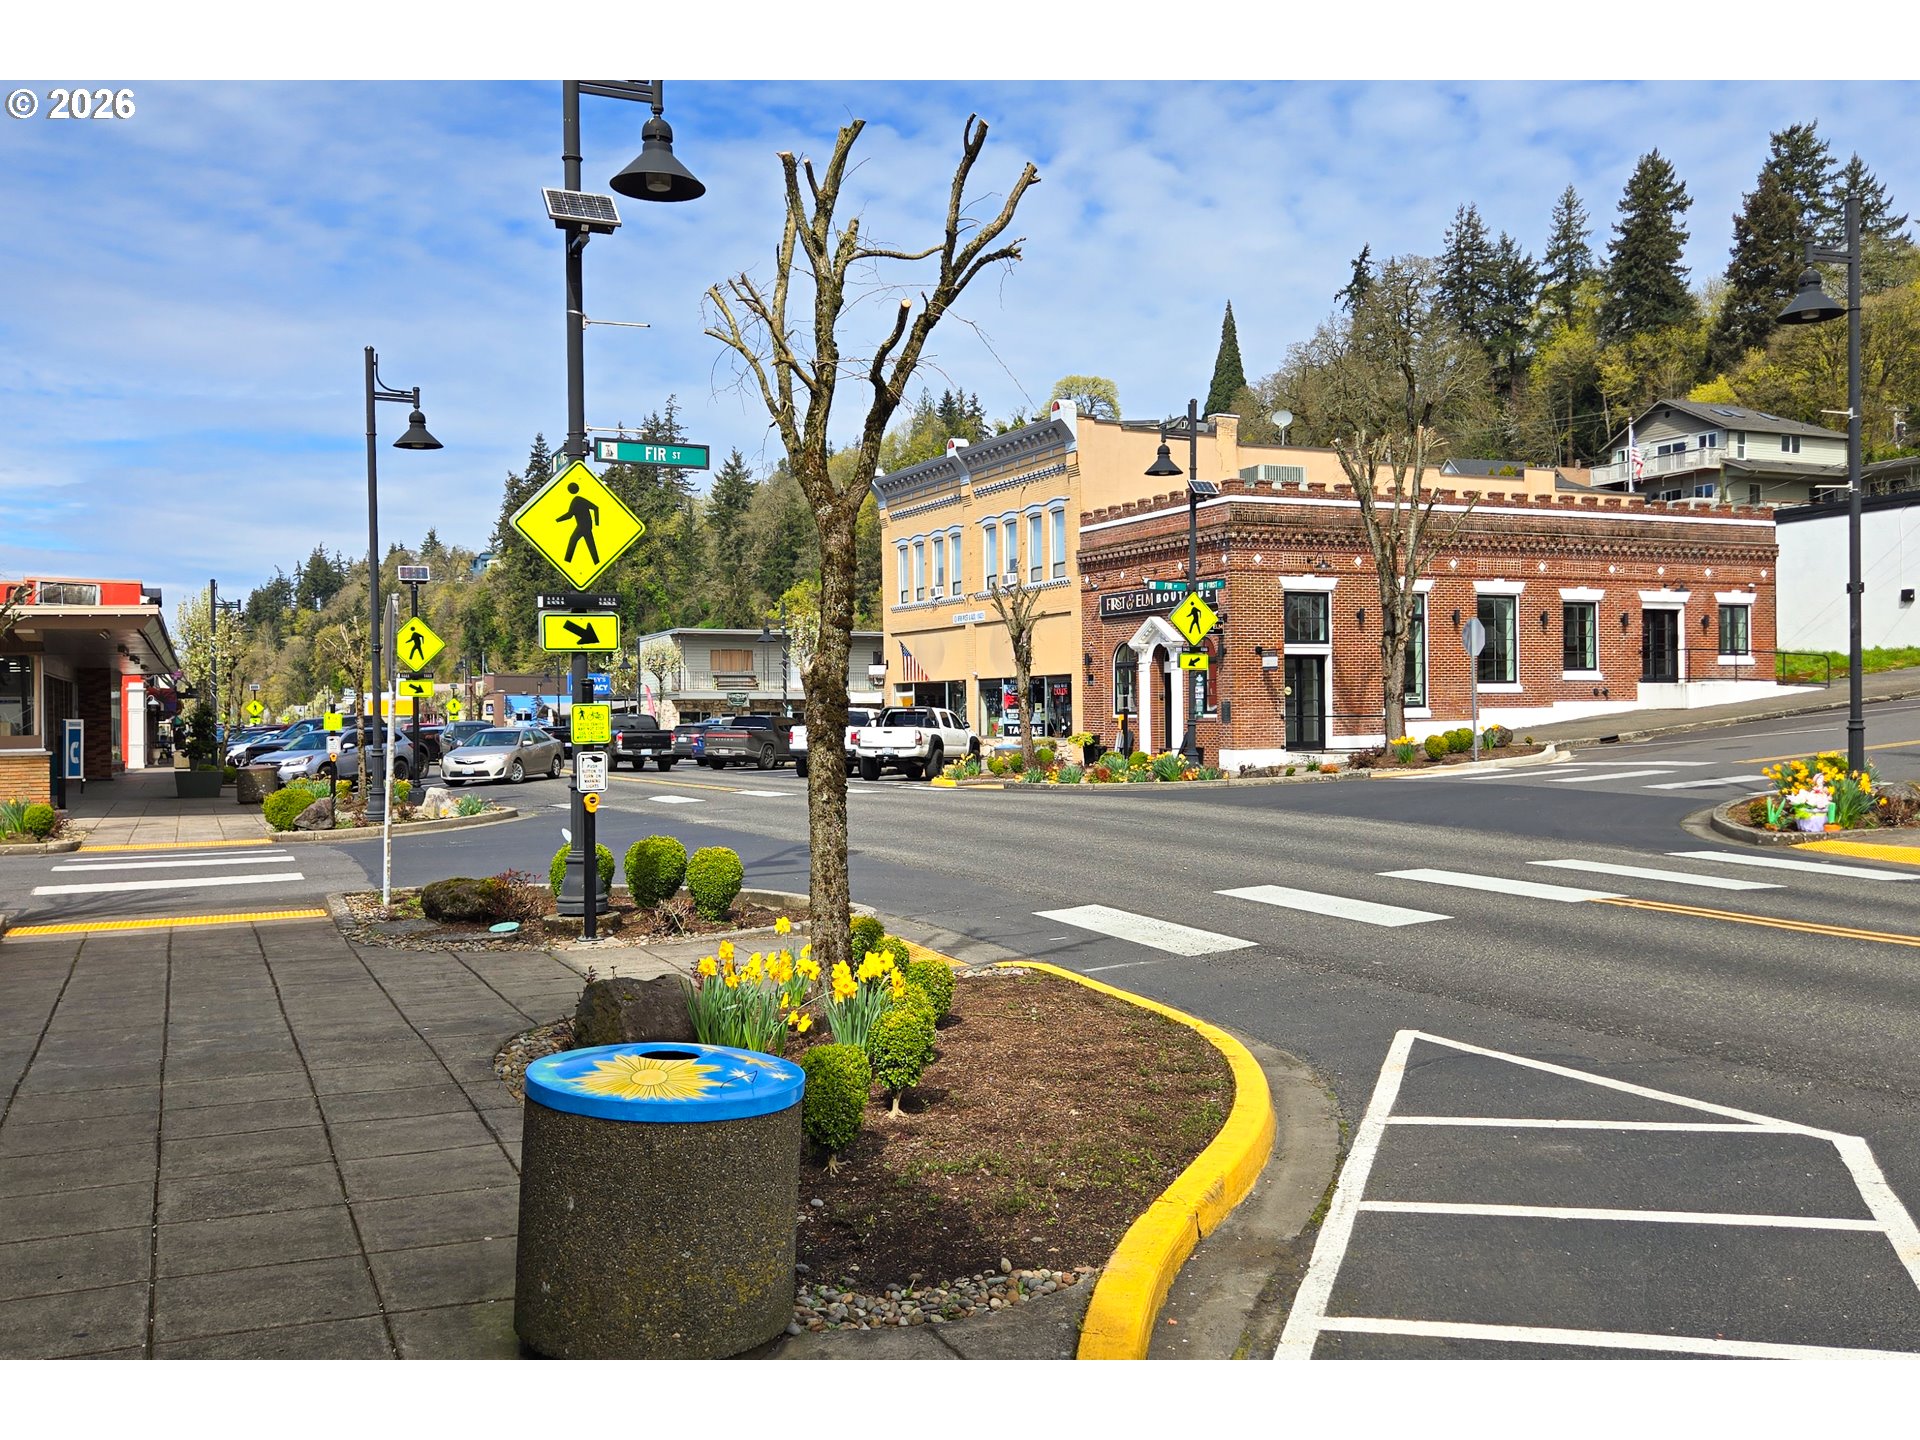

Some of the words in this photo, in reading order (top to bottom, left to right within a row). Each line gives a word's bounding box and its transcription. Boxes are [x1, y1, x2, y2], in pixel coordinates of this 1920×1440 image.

[645, 446, 667, 462] FIR
[671, 451, 681, 460] ST
[1106, 596, 1126, 611] FIRST
[1126, 593, 1135, 610] &
[1135, 592, 1154, 608] ELM
